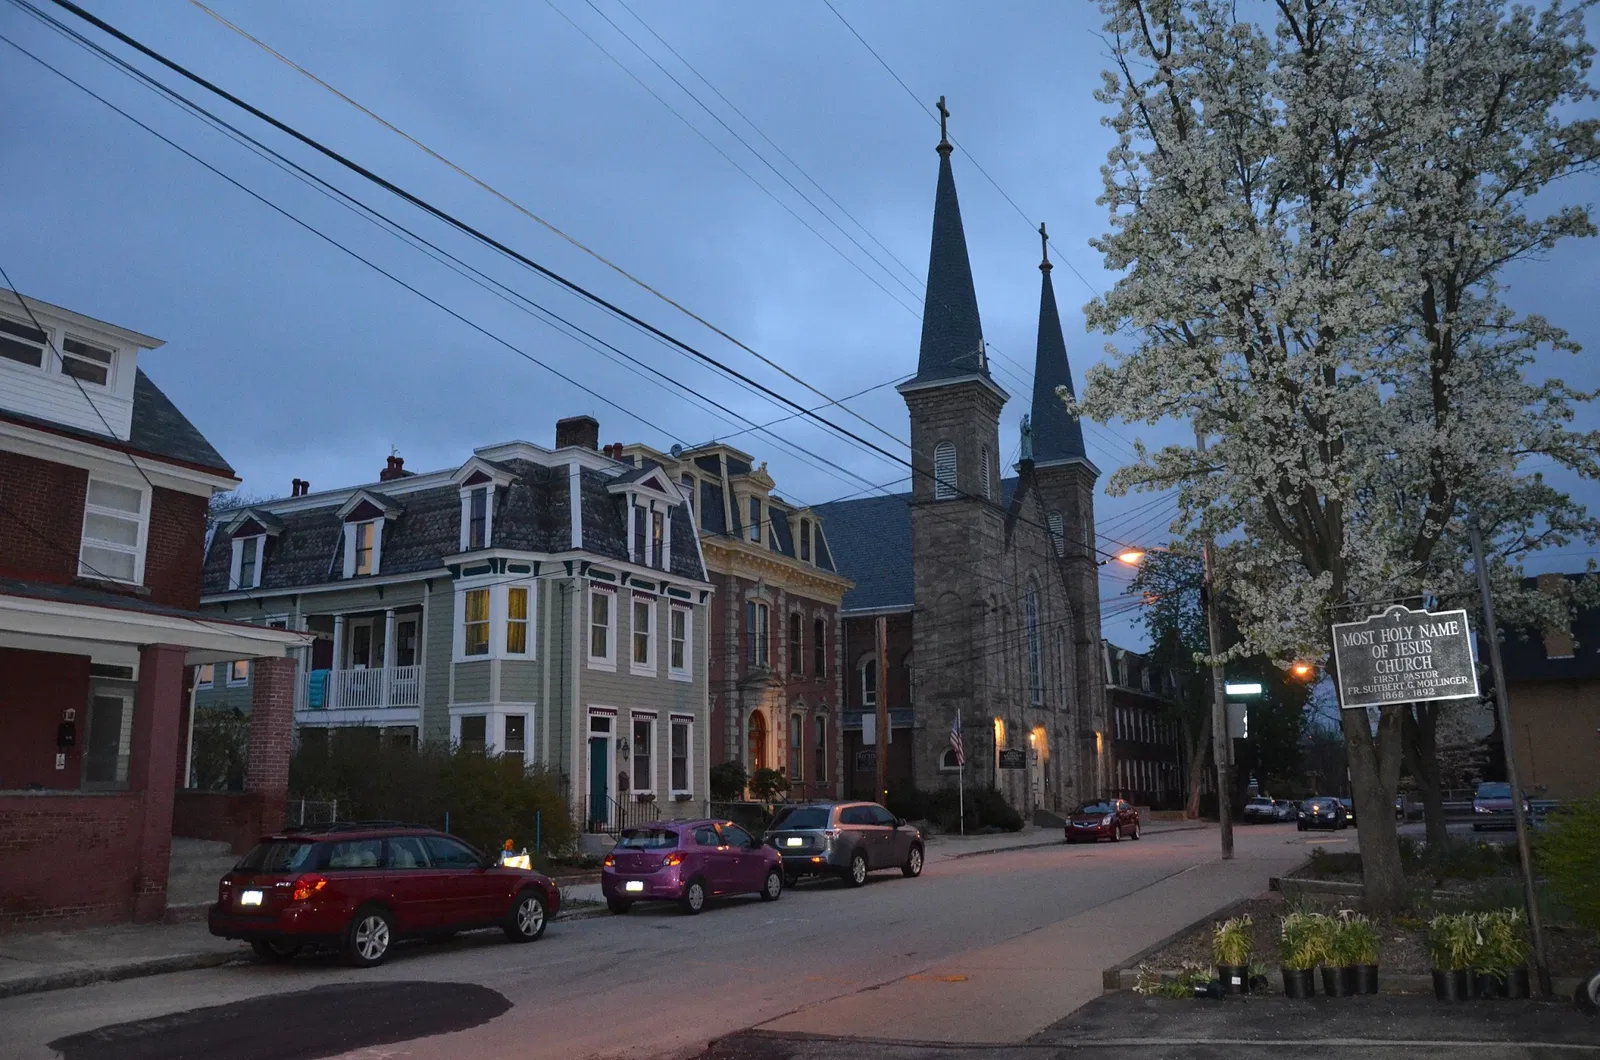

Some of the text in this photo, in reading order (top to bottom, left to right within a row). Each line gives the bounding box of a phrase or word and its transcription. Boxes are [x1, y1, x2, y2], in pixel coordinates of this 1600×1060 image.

[1342, 621, 1460, 647] MOST HOLY NAME
[1371, 639, 1432, 659] OF JESUS
[1375, 655, 1433, 674] CHURCH
[1347, 686, 1362, 696] FR.
[1363, 681, 1404, 693] SUITBERT
[1416, 675, 1468, 688] MOLLINGER
[1373, 670, 1438, 684] FIRST PASTOR
[1381, 690, 1405, 700] 1868
[1413, 687, 1436, 697] 1892
